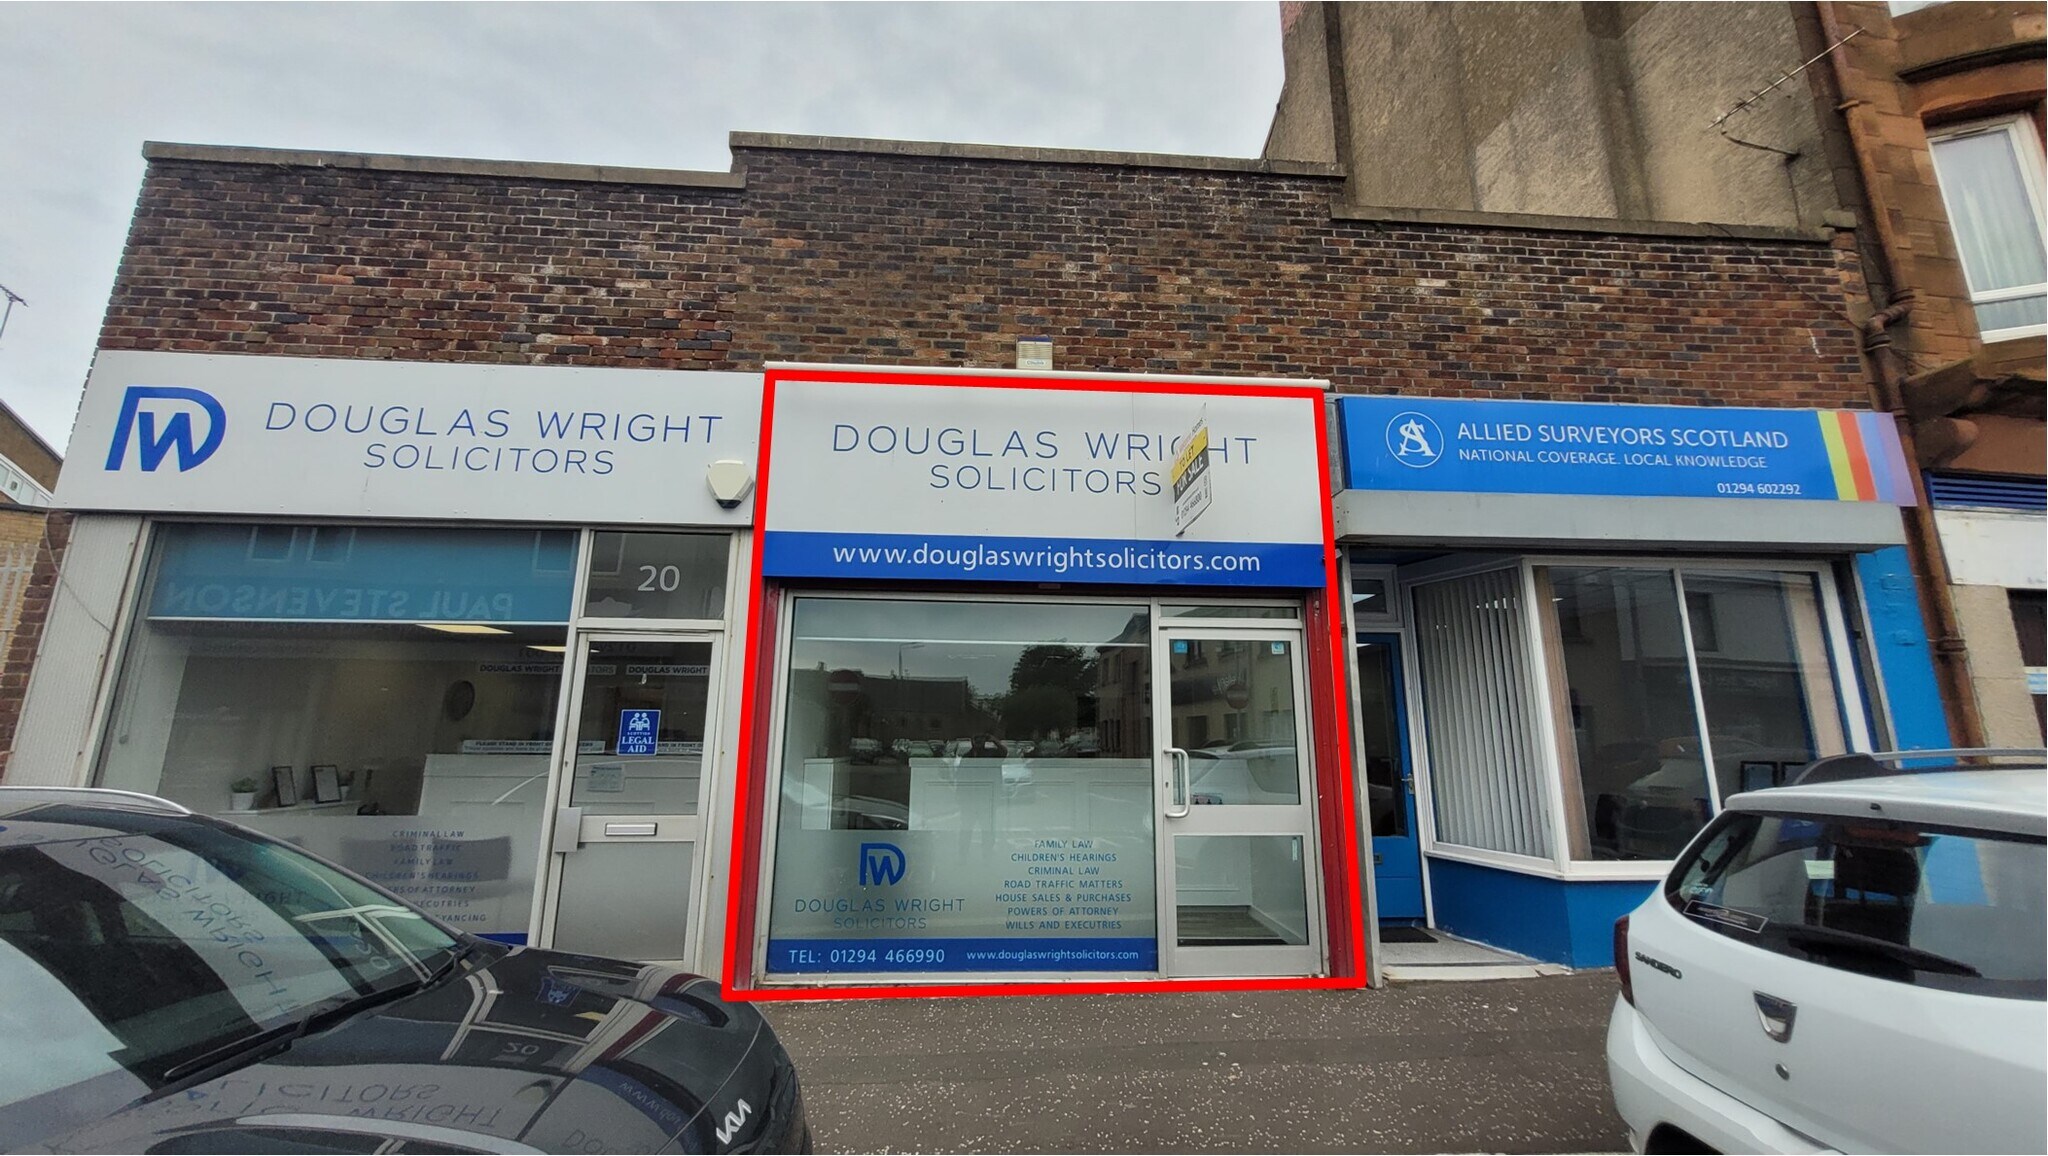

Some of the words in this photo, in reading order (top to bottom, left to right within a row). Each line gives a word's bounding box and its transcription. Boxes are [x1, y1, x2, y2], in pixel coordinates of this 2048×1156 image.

[265, 402, 510, 438] DOUGLAS
[537, 411, 723, 444] WRIGHT
[833, 424, 1059, 459] DOUGLAS
[1457, 422, 1532, 442] ALLIED
[1537, 425, 1666, 446] SURVEYORS
[1671, 429, 1789, 449] SCOTLAND
[363, 443, 614, 475] SOLICITORS
[1459, 449, 1535, 463] NATIONAL
[1537, 450, 1621, 465] COVERAGE.
[1624, 453, 1672, 467] LOCAL
[1675, 455, 1768, 469] KNOWLEDGE
[929, 465, 1162, 496] SOLICITORS
[1717, 482, 1755, 494] 01294
[1757, 483, 1802, 495] 602292
[833, 542, 1261, 572] www.douglaswrightsolicitors.com
[637, 565, 681, 592] 20
[628, 666, 671, 674] DOUGLAS
[672, 666, 708, 674] WRIGHT
[621, 736, 655, 745] LEGAL
[627, 745, 648, 753] AID
[392, 830, 443, 839] CRIMINAL
[443, 830, 465, 838] LAW
[1034, 839, 1068, 849] FAMILY
[1071, 839, 1094, 849] LAW
[1010, 853, 1065, 862] CHILDREN'S
[1069, 853, 1118, 862] HEARINGS
[1027, 866, 1074, 876] CRIMINAL
[1077, 866, 1100, 876] LAW
[422, 885, 476, 895] ATTORNEY
[1003, 879, 1031, 889] ROAD
[1035, 879, 1075, 889] TRAFFIC
[1079, 879, 1124, 889] MATTERS
[995, 893, 1027, 903] HOUSE
[1032, 893, 1061, 903] SALES
[1065, 893, 1073, 903] &
[1076, 893, 1132, 903] PURCHASES
[794, 898, 886, 913] DOUGLAS
[895, 898, 966, 912] WRIGHT
[1007, 906, 1048, 916] POWERS
[1051, 906, 1065, 916] OF
[1069, 906, 1120, 916] ATTORNEY
[833, 917, 927, 930] SOLICITORS
[1005, 920, 1035, 930] WILLS
[1038, 920, 1060, 930] AND
[1064, 920, 1122, 930] EXECUTRIES
[788, 950, 821, 964] TEL:
[830, 950, 877, 963] 01294
[885, 949, 945, 964] 466990
[966, 949, 1139, 962] www.douglaswrightsolicitors.com
[1635, 951, 1682, 980] SANDERO
